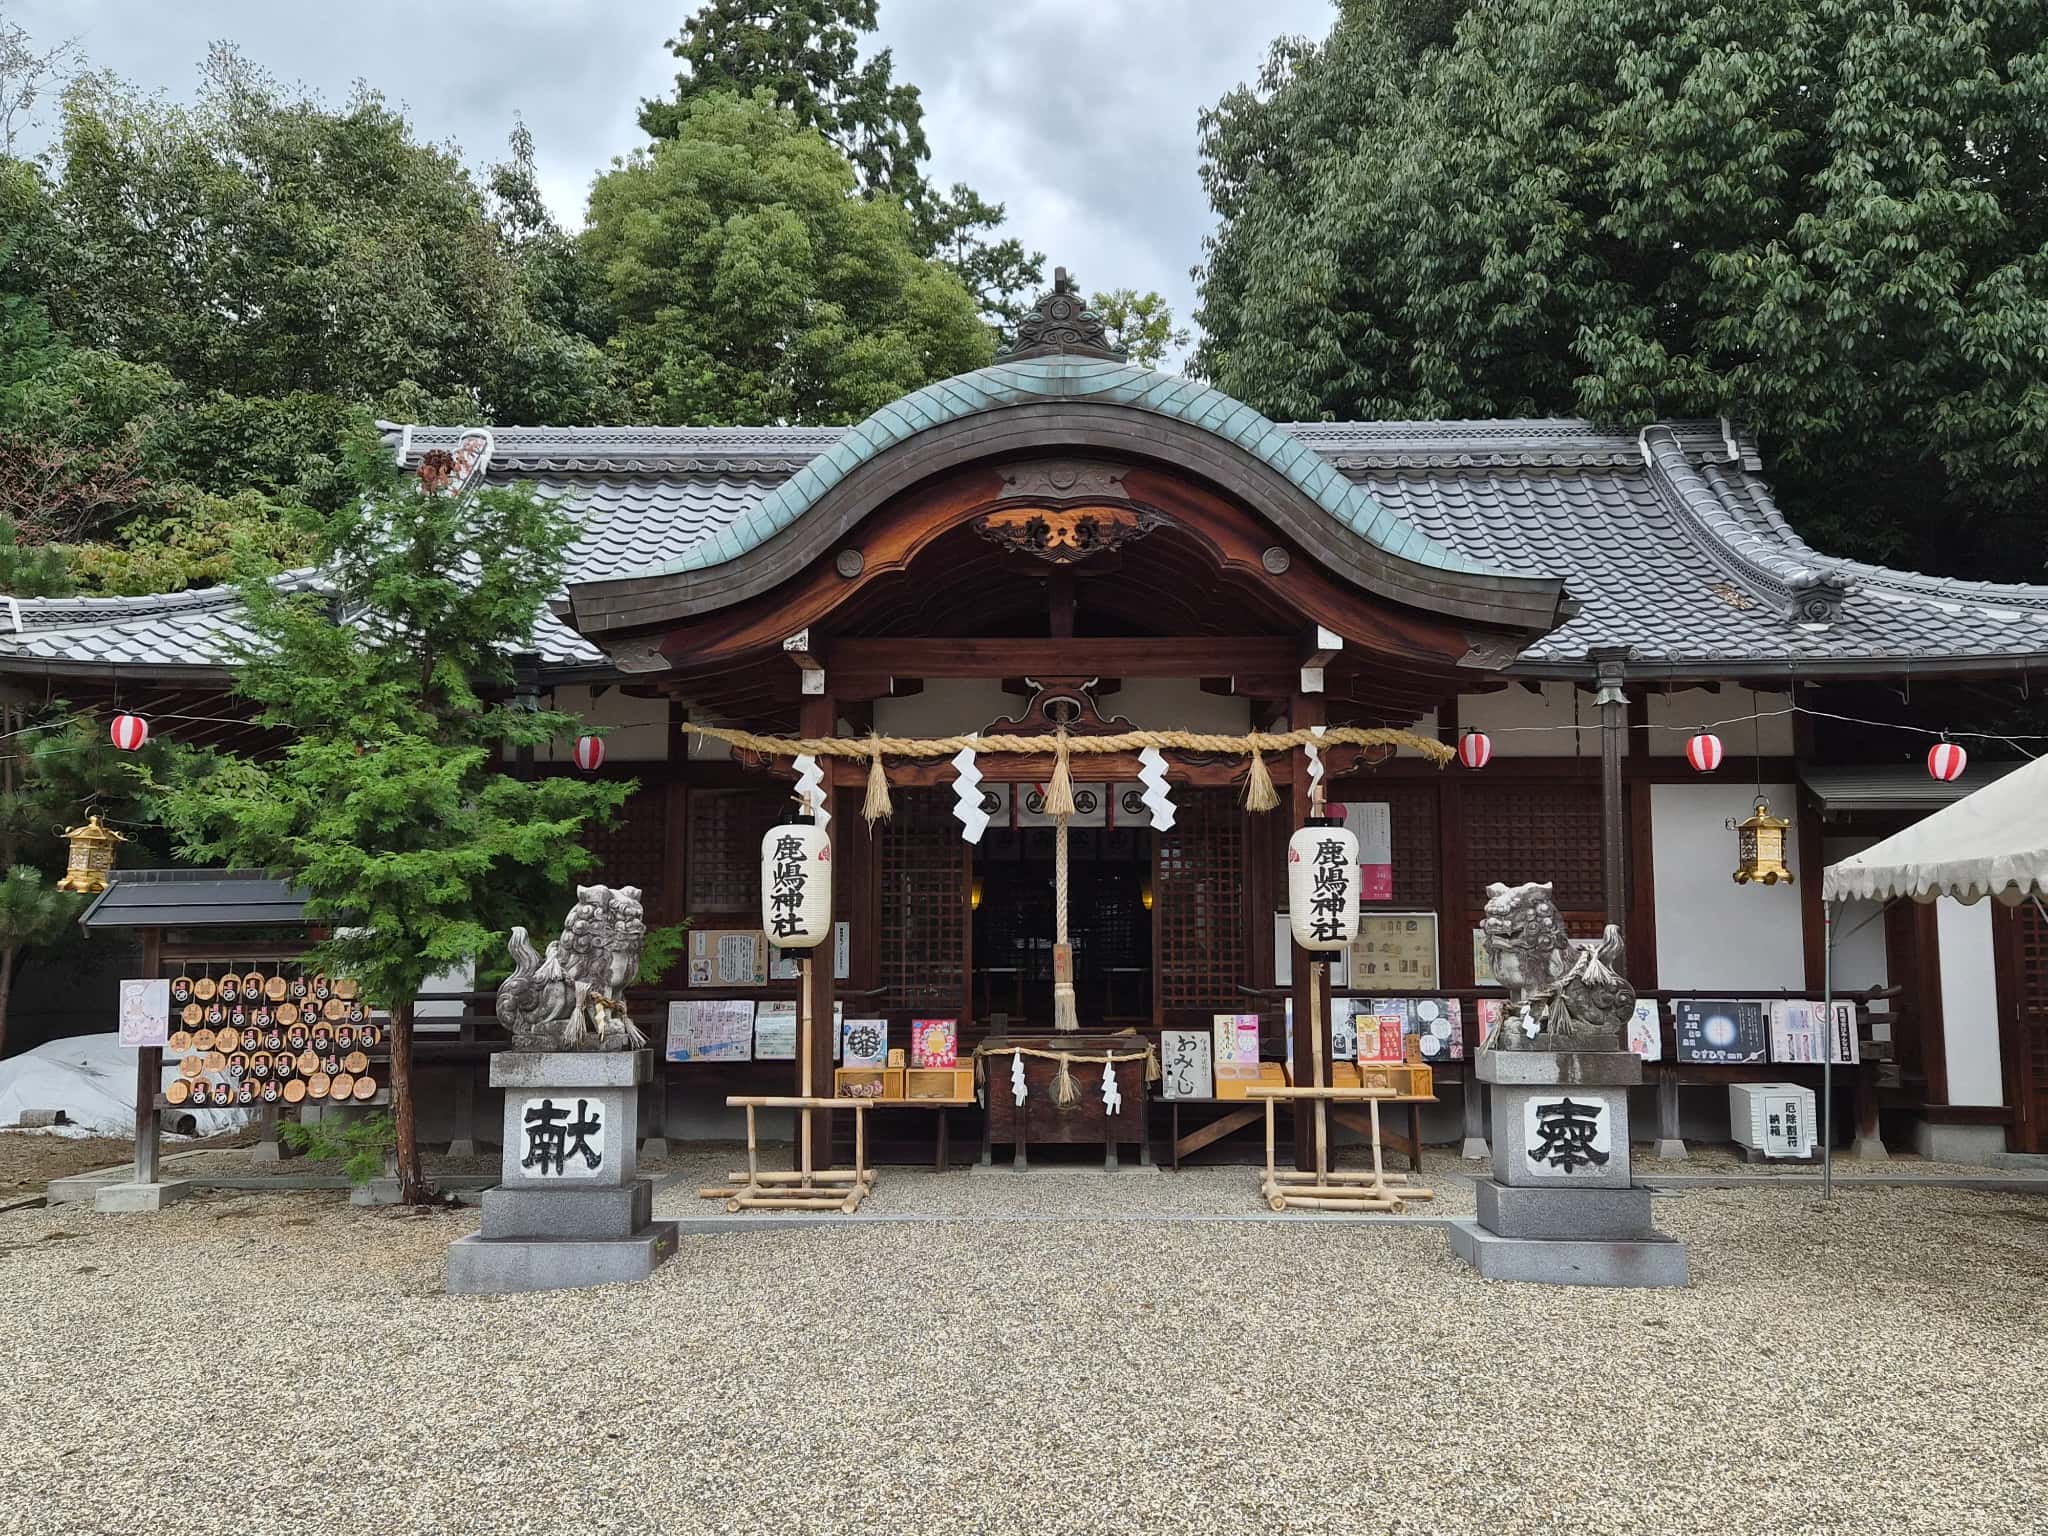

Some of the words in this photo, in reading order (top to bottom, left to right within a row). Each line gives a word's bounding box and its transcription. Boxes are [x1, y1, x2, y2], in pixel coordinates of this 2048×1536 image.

[770, 834, 808, 938] 鹿嶋神社
[1309, 837, 1350, 942] 鹿嶋神社
[1174, 1034, 1197, 1095] おみくじ
[1769, 1114, 1781, 1137] 納箱
[1785, 1102, 1798, 1148] 厄除割符
